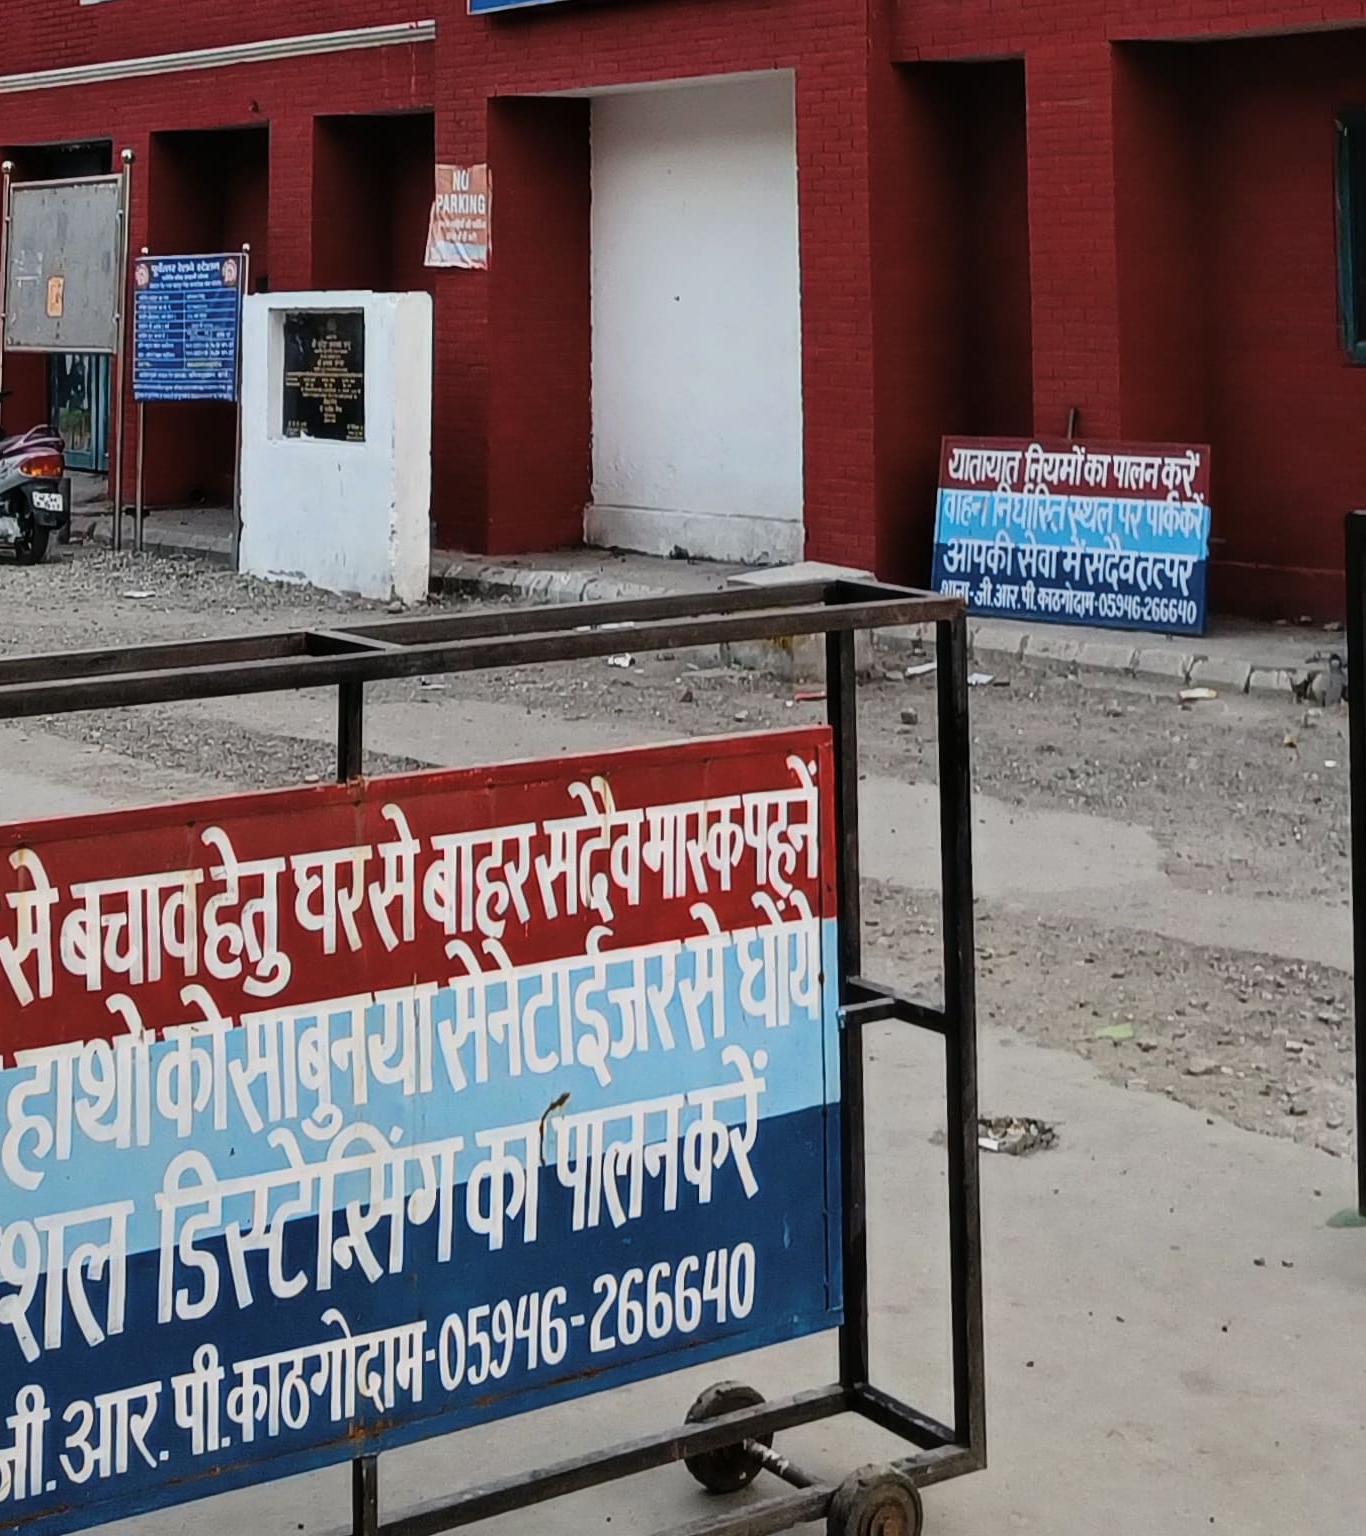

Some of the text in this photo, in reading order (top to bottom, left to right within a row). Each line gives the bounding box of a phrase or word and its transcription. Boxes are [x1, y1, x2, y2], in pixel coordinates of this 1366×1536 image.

[436, 193, 487, 215] PARKING
[452, 168, 470, 192] NO
[948, 443, 1200, 497] यातायात नियमों का पालन करें
[943, 488, 992, 527] वाहन
[1067, 495, 1117, 540] स्थल
[1116, 497, 1146, 540] पर
[943, 529, 1198, 597] आपकी सेवा में सदैव तत्पर
[60, 869, 204, 993] बचाव
[201, 825, 292, 997] हेतु
[291, 844, 372, 955] घर
[368, 803, 420, 953] से
[422, 822, 537, 939] बाहर
[534, 775, 644, 922] सदैव
[741, 755, 819, 899] पहनें
[156, 984, 234, 1138] को
[228, 992, 372, 1141] साबुन
[367, 980, 439, 1096] या
[437, 925, 682, 1093] सेनेटाईजर
[678, 901, 733, 1052] से
[465, 1120, 542, 1252] का
[552, 1093, 686, 1232] पालन
[682, 1044, 769, 1204] करें
